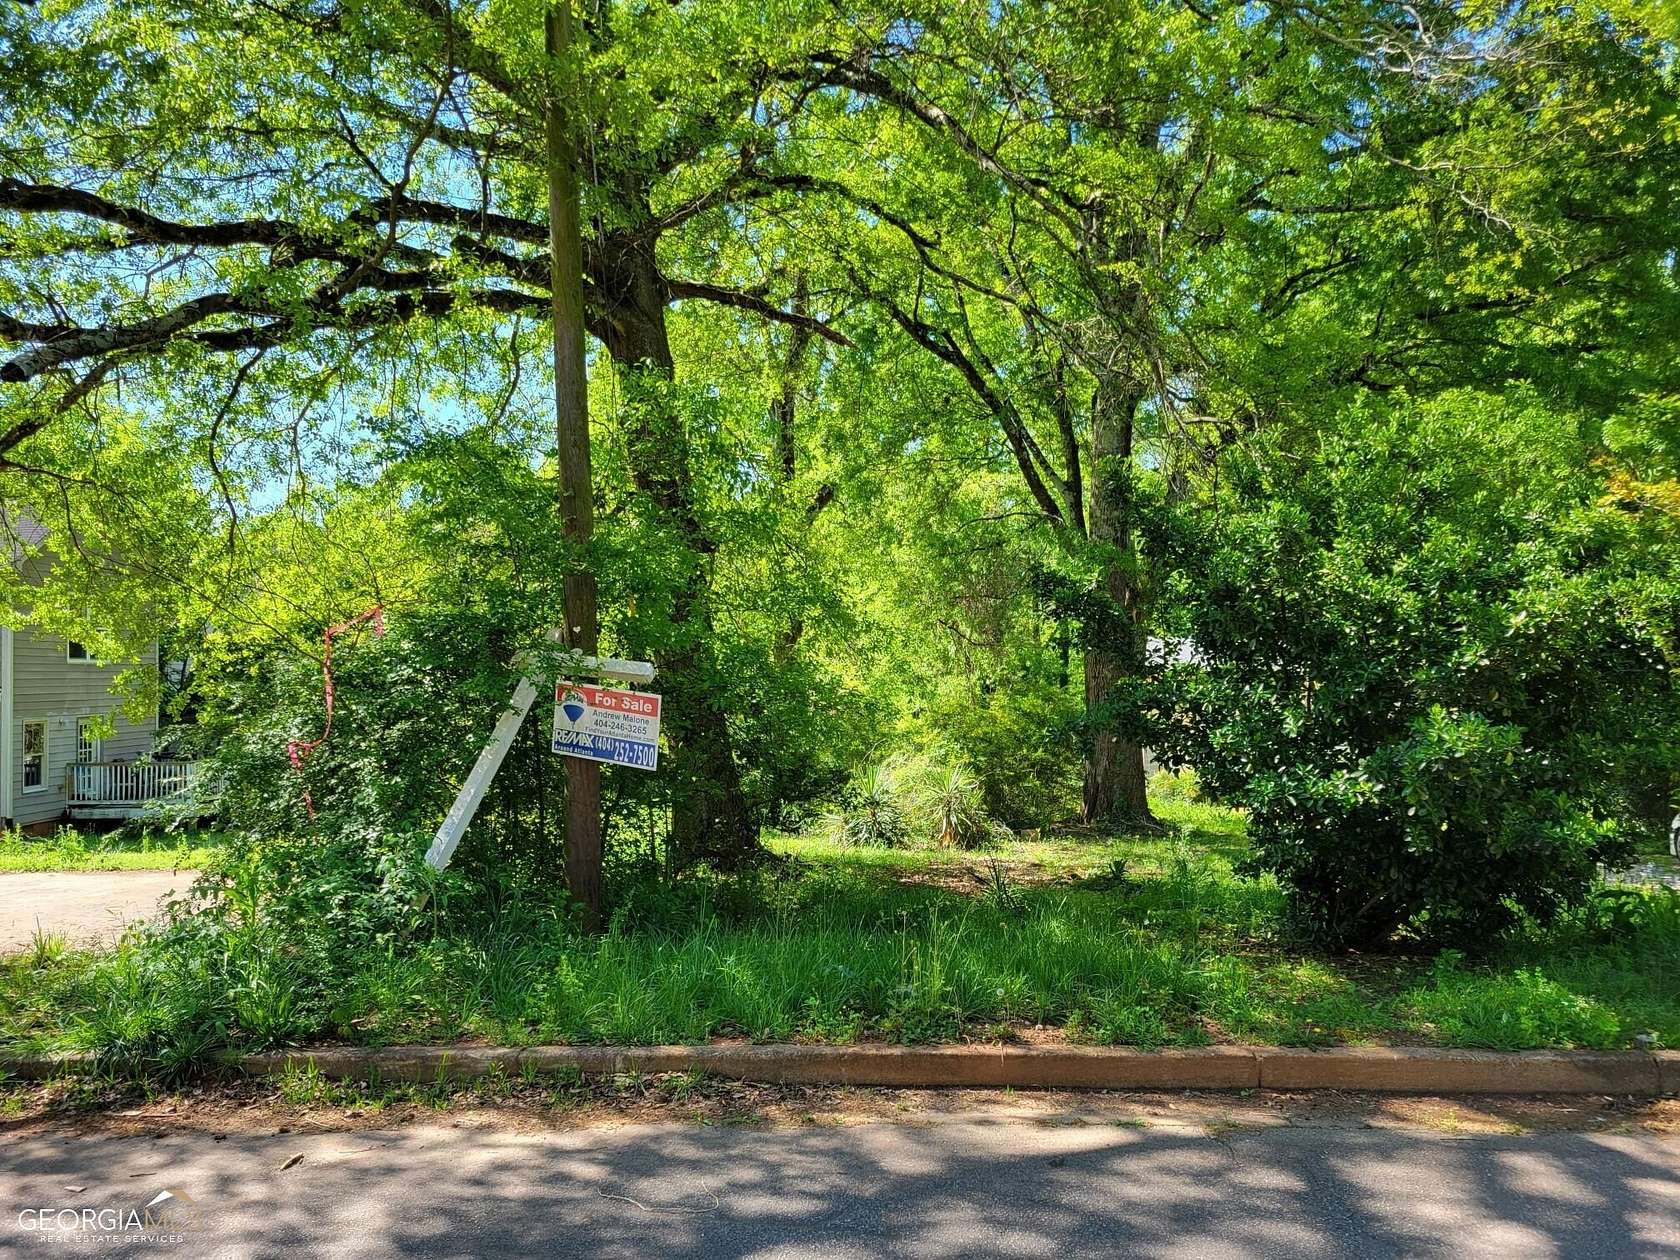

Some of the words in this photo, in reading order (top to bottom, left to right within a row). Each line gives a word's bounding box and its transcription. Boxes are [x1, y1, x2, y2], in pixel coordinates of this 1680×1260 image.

[595, 692, 617, 707] For
[621, 697, 653, 713] Sale
[592, 709, 621, 721] Andrew
[623, 714, 650, 725] Malone
[593, 719, 648, 735] 404-246-3265
[554, 729, 594, 748] RE/MAX
[596, 736, 614, 751] (404)
[614, 742, 655, 766] 252-7500
